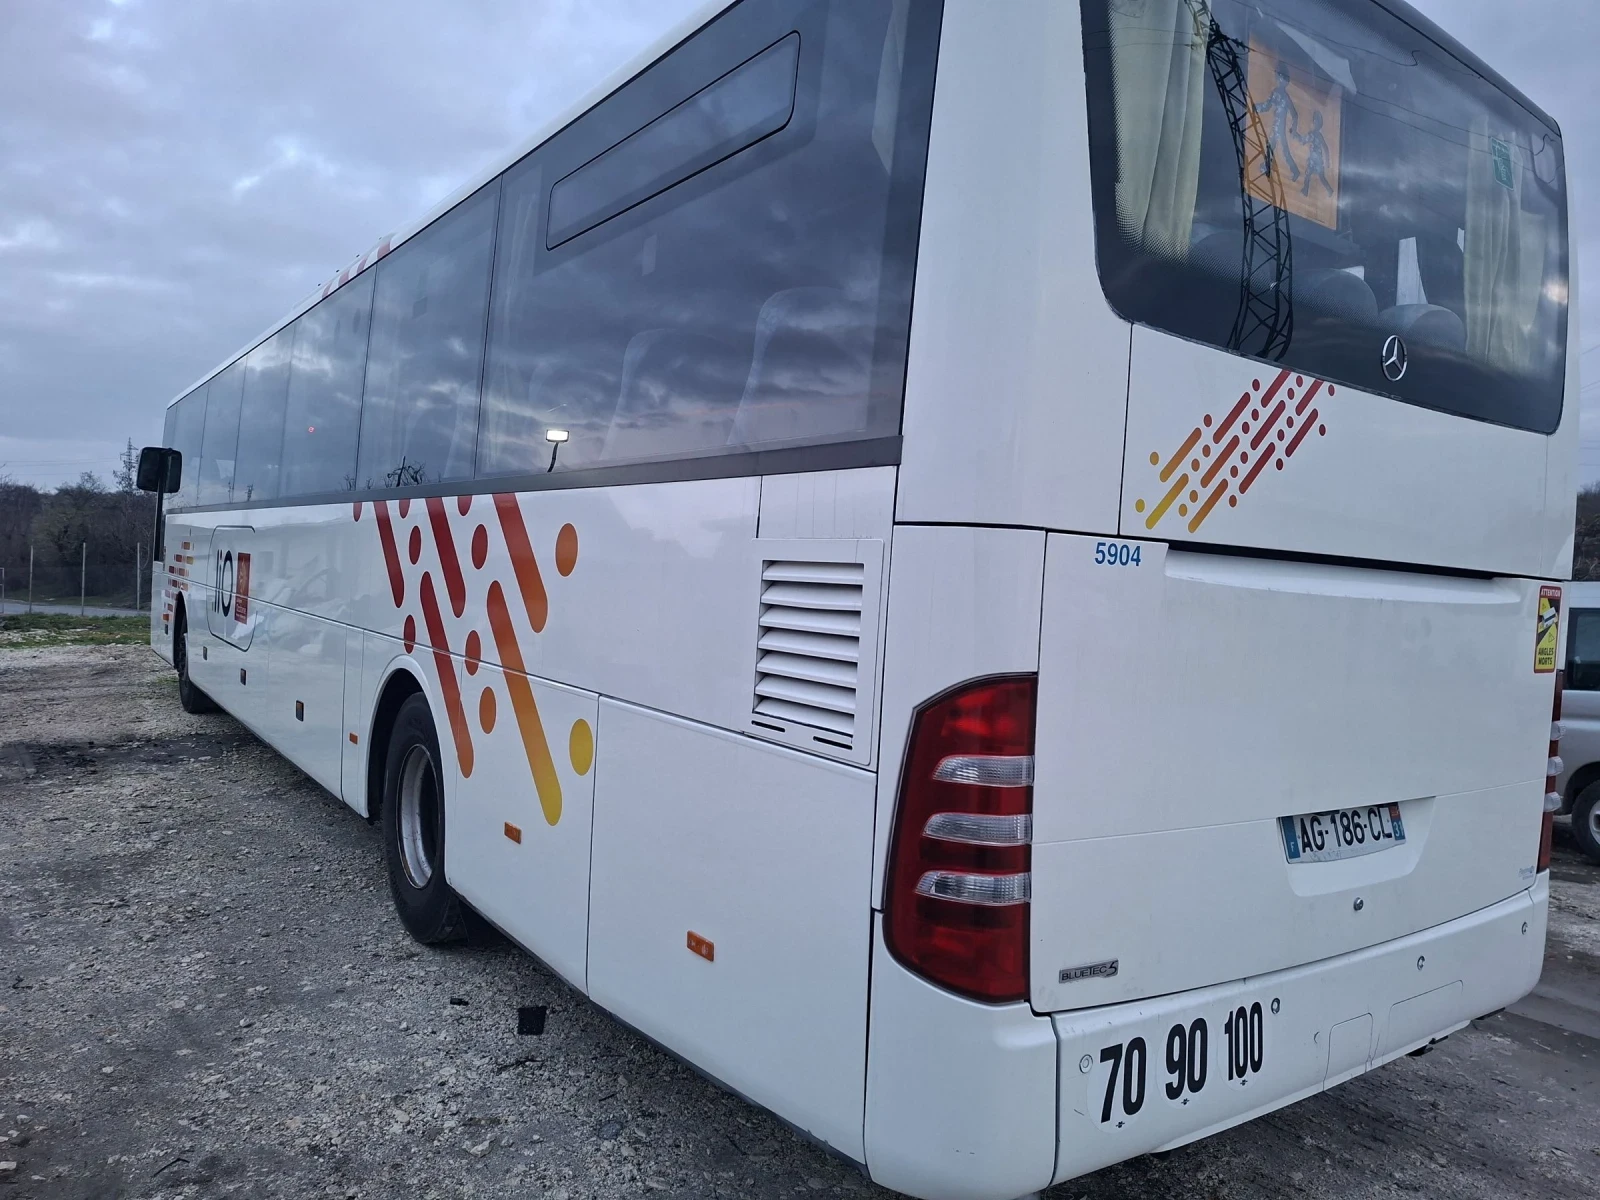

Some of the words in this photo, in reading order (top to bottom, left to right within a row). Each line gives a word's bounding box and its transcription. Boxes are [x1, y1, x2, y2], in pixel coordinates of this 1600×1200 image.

[1094, 542, 1141, 567] 5904
[1541, 588, 1561, 597] ATTENTION
[1538, 647, 1554, 656] ANGLES
[1538, 657, 1553, 665] MORTS
[1301, 807, 1392, 853] AG-186-CL
[1099, 1036, 1147, 1124] 70
[1165, 1017, 1208, 1101] 90
[1224, 1001, 1264, 1082] 100
